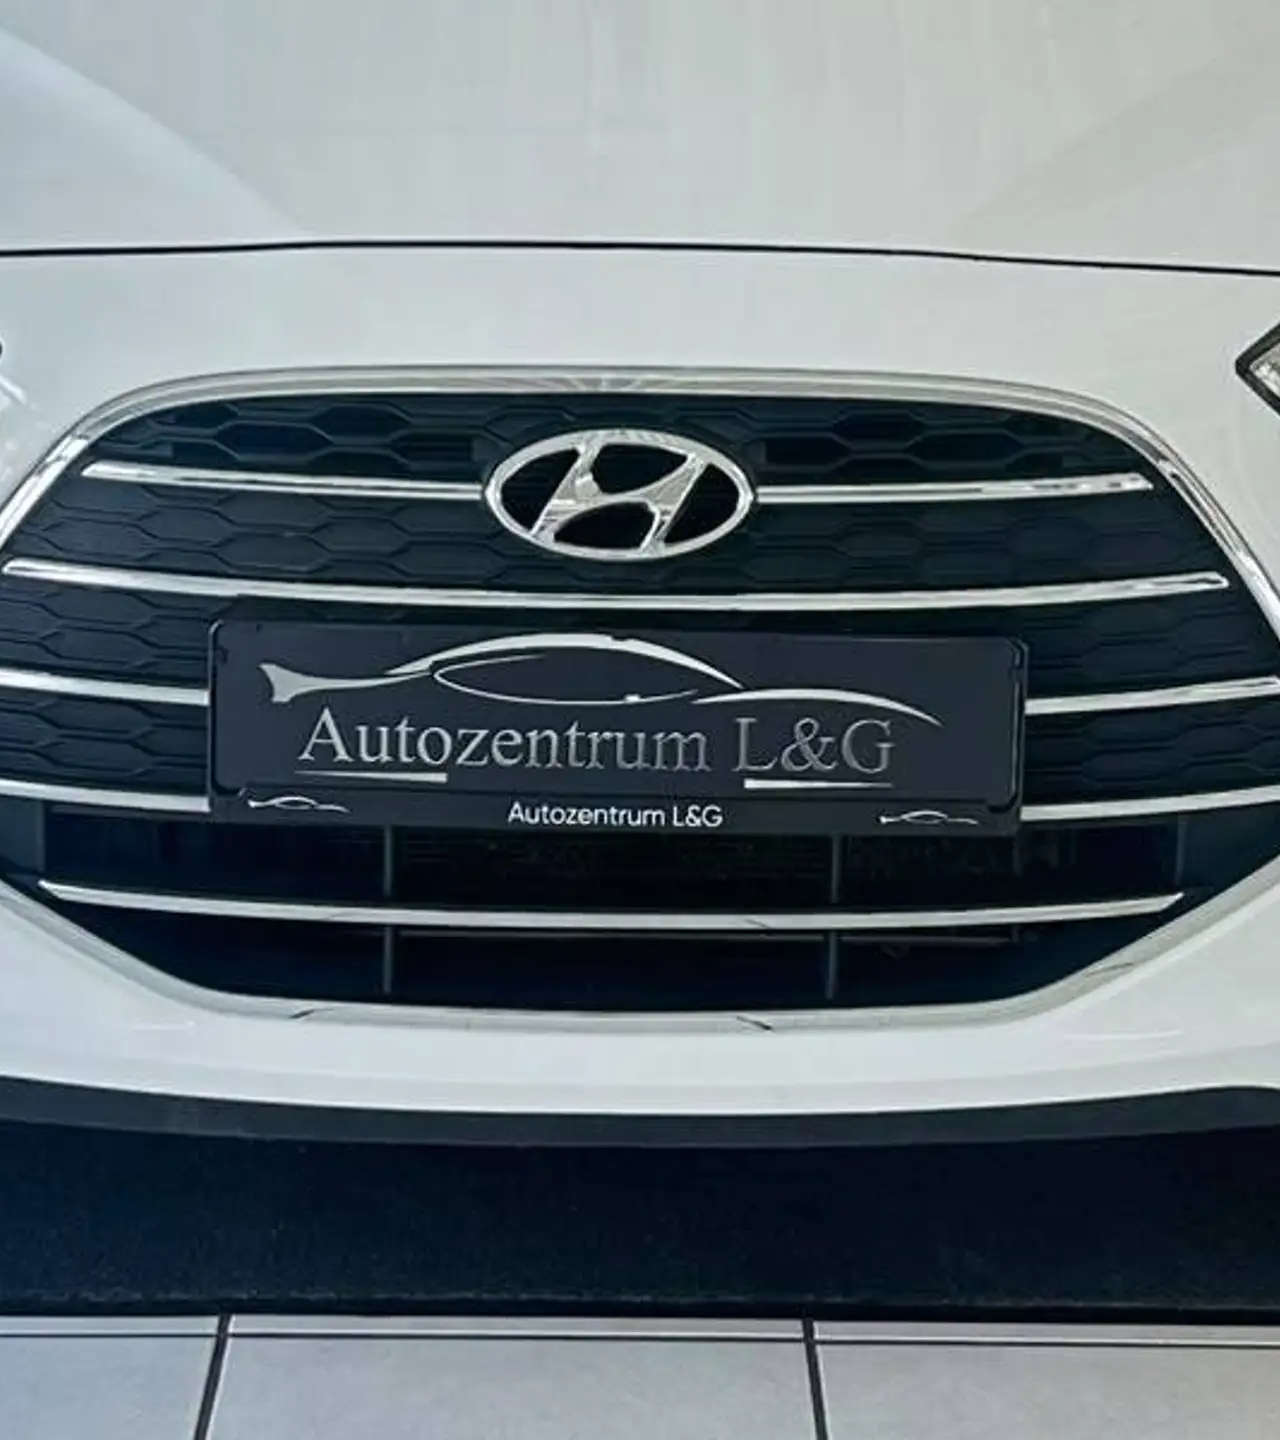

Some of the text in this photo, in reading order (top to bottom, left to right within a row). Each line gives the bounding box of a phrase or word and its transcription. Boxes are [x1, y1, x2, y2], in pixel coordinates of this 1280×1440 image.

[297, 707, 896, 775] Autozentrum L&G
[507, 800, 724, 828] Autozentrum L&G
